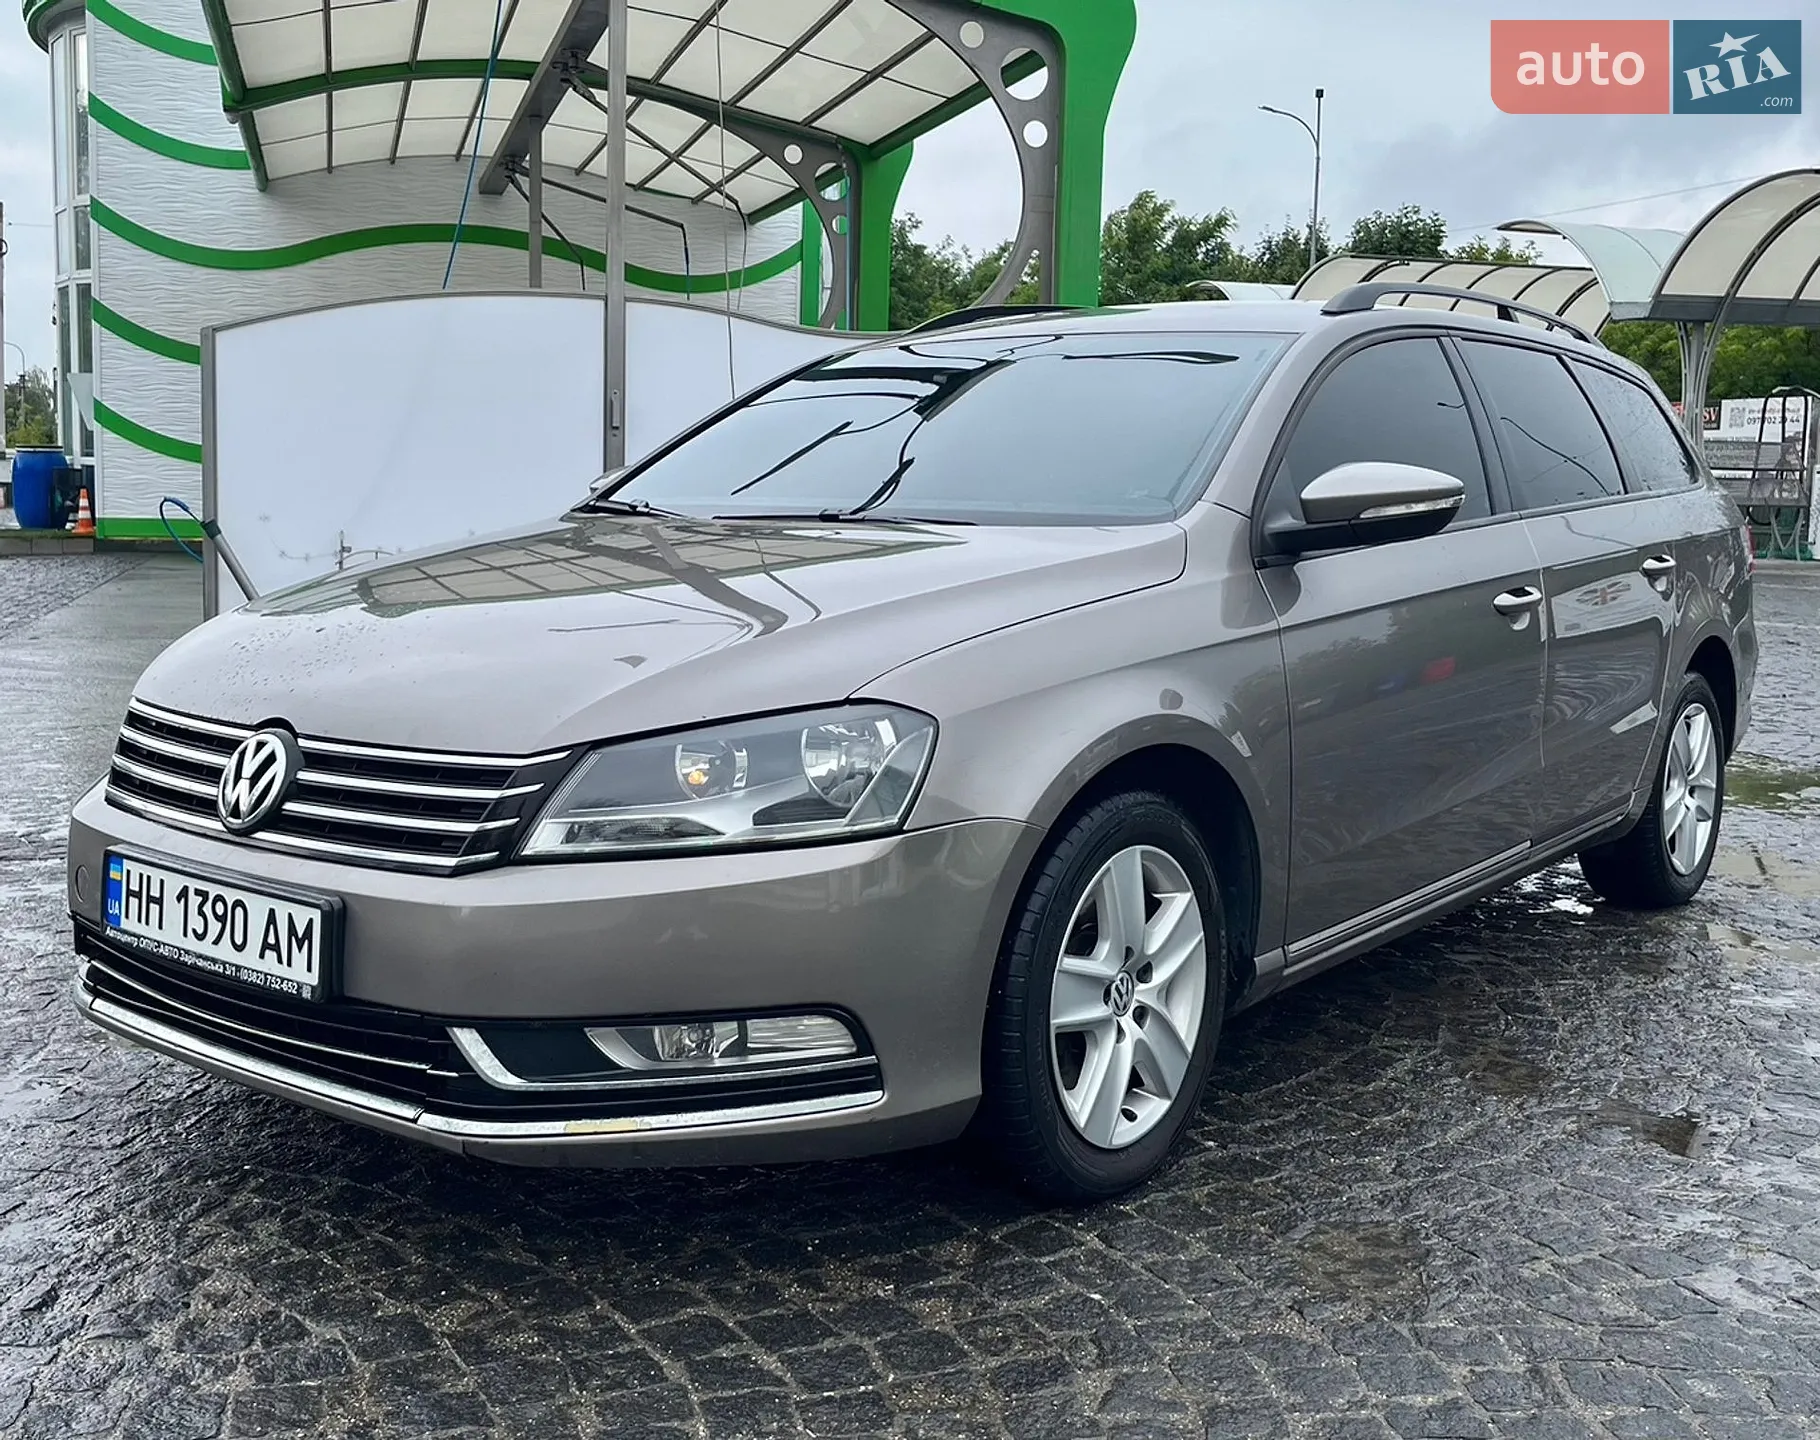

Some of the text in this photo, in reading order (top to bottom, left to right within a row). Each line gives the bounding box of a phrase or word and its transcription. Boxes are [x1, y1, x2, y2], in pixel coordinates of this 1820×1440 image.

[107, 898, 121, 916] UA
[124, 868, 314, 973] HH 1390 AM
